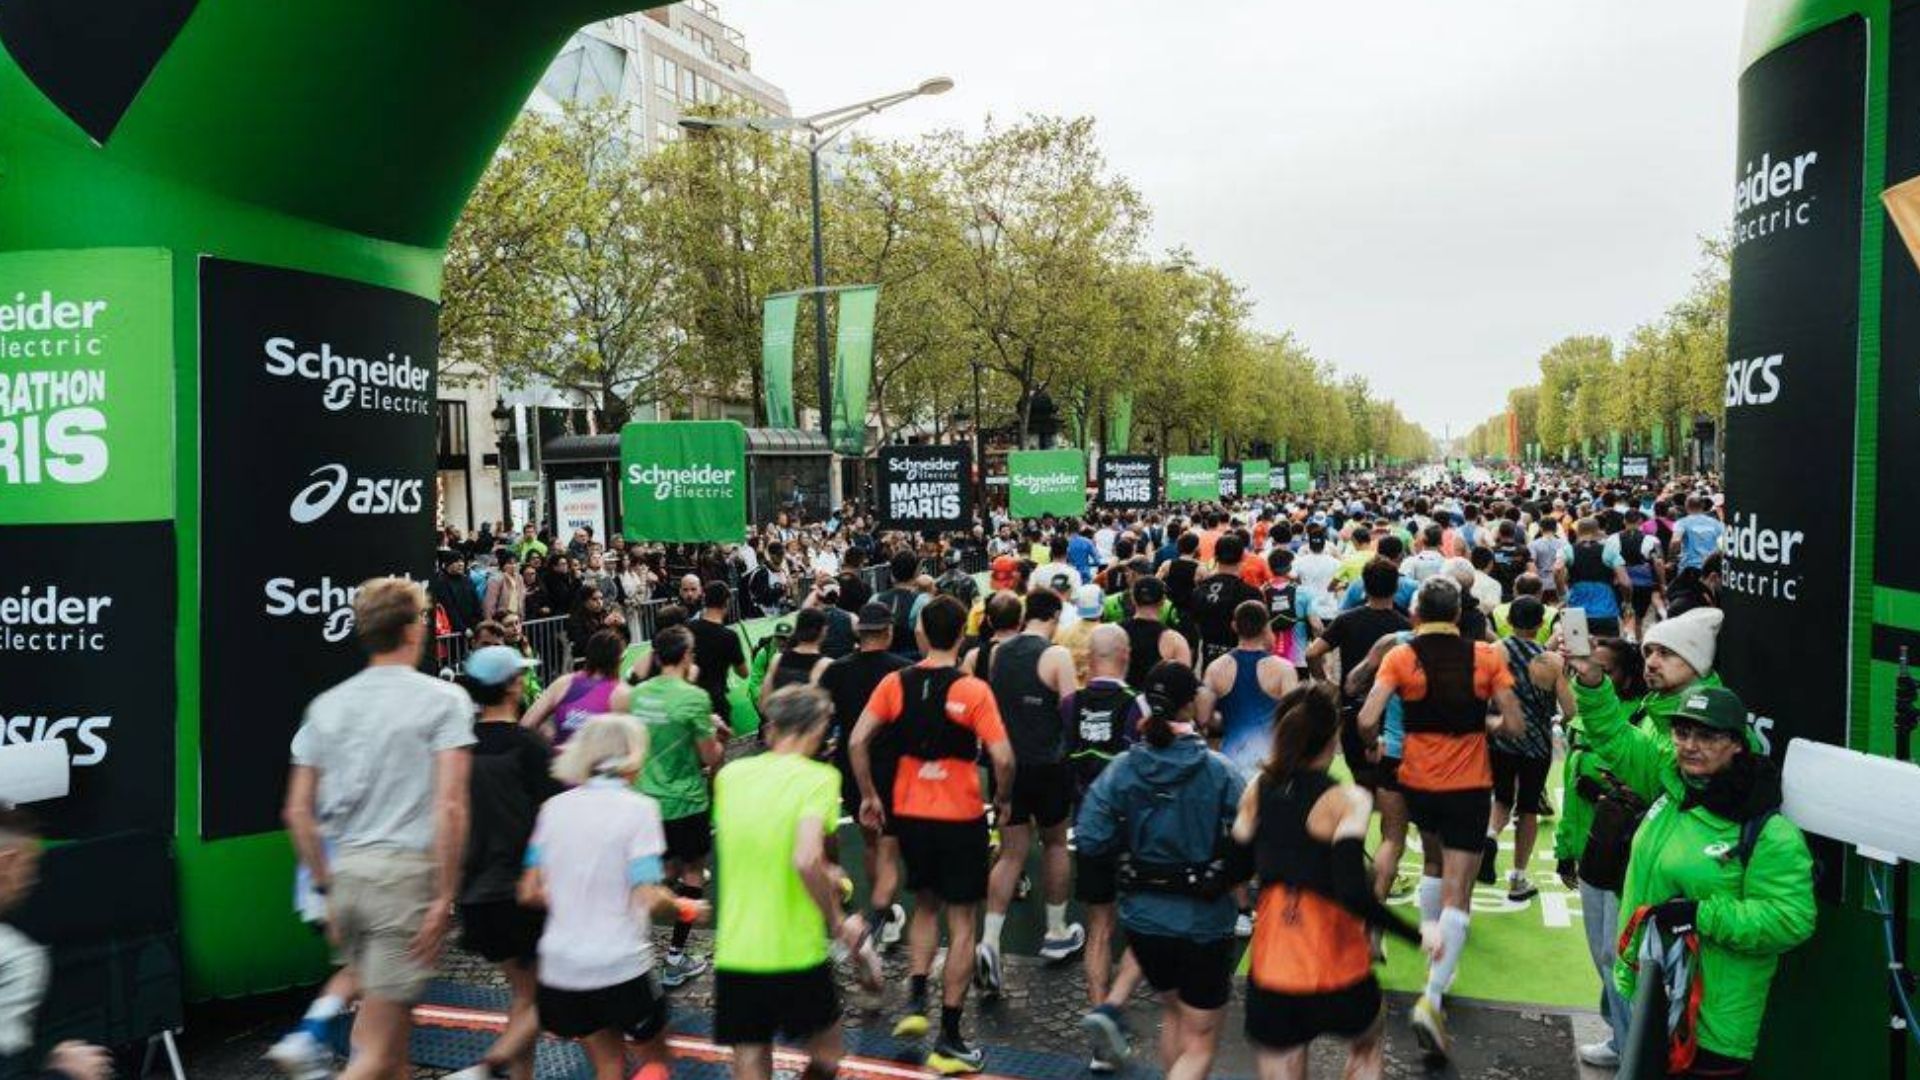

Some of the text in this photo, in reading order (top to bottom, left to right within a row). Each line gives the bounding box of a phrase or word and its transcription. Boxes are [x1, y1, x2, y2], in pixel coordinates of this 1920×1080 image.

[264, 337, 430, 391] Schneider
[360, 387, 429, 415] Electric
[628, 463, 736, 485] Schneider
[889, 457, 959, 472] Schneider
[673, 485, 734, 498] Electric
[898, 494, 961, 519] PARIS
[0, 585, 113, 624] eider
